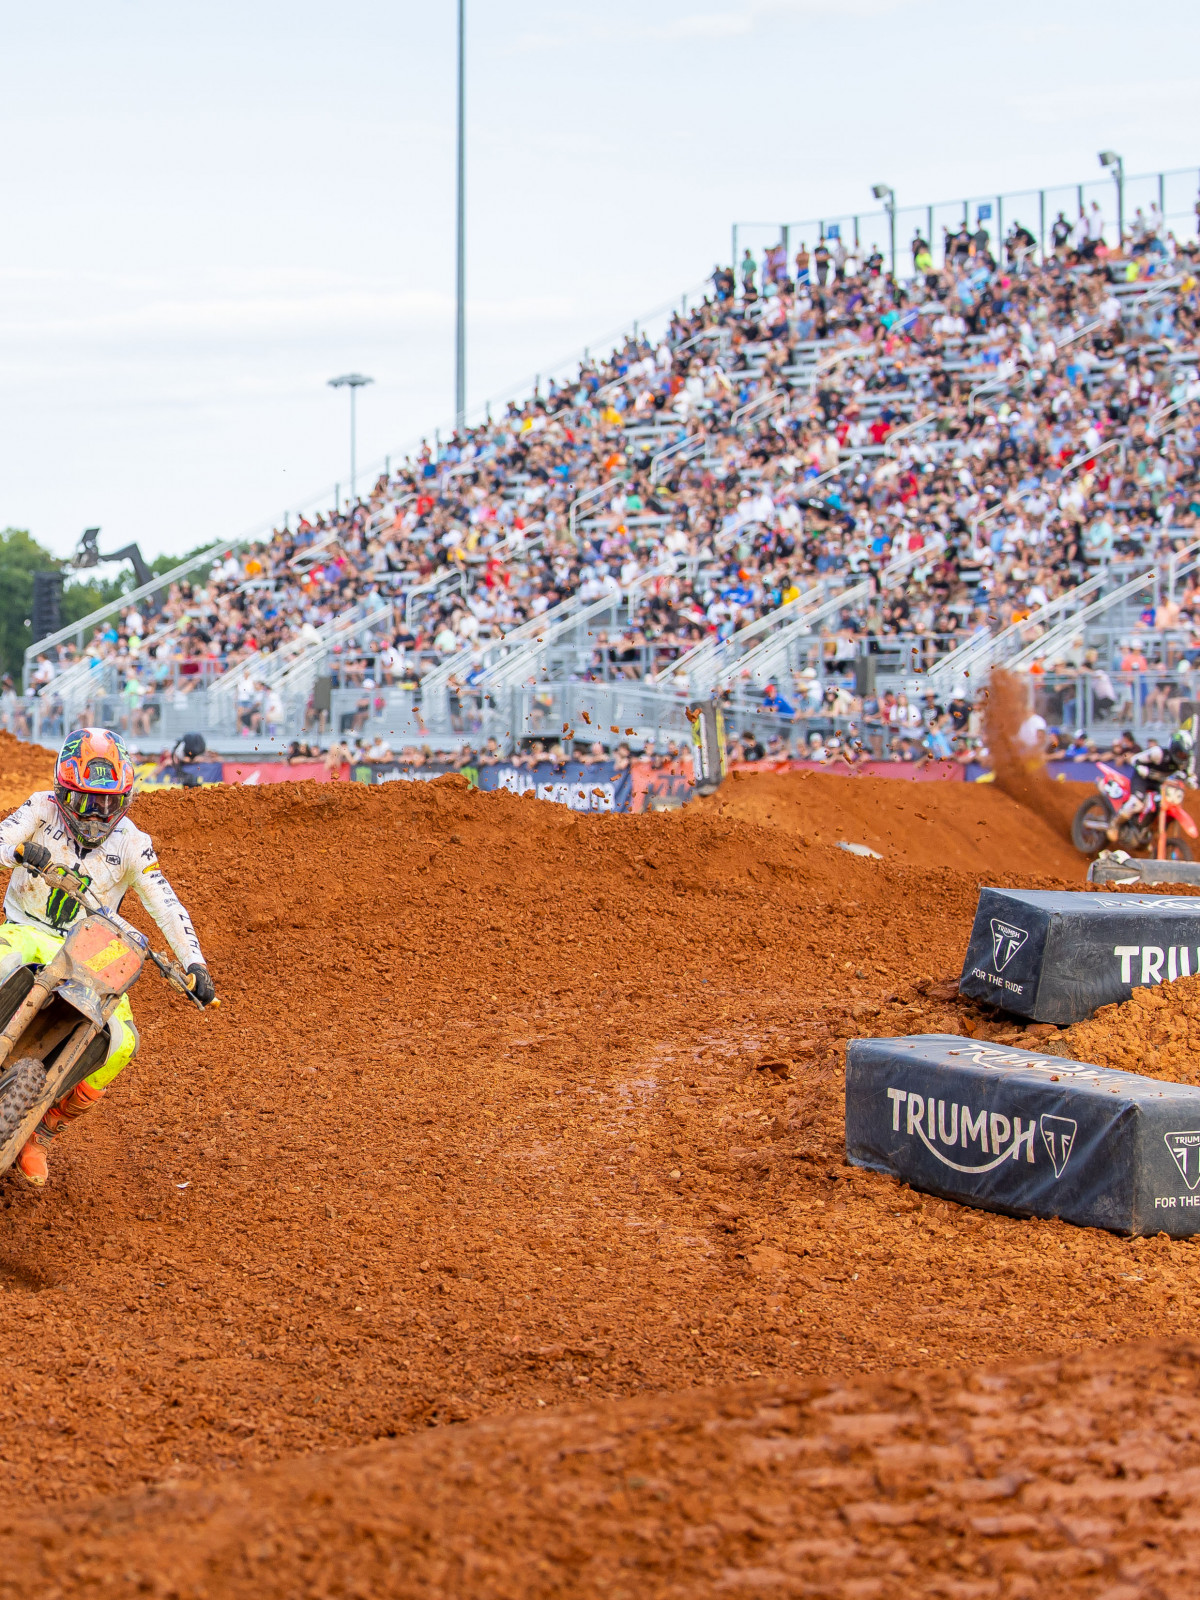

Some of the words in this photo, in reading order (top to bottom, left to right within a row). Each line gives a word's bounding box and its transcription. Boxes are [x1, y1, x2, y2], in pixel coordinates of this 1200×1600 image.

[998, 924, 1020, 938] TRIUMPH
[82, 939, 130, 973] 1
[971, 967, 986, 981] FOR
[988, 973, 1004, 987] THE
[1005, 980, 1024, 995] RIDE
[887, 1087, 1036, 1173] TRIUMPH
[1154, 1197, 1177, 1209] FOR
[1179, 1195, 1200, 1207] THE
